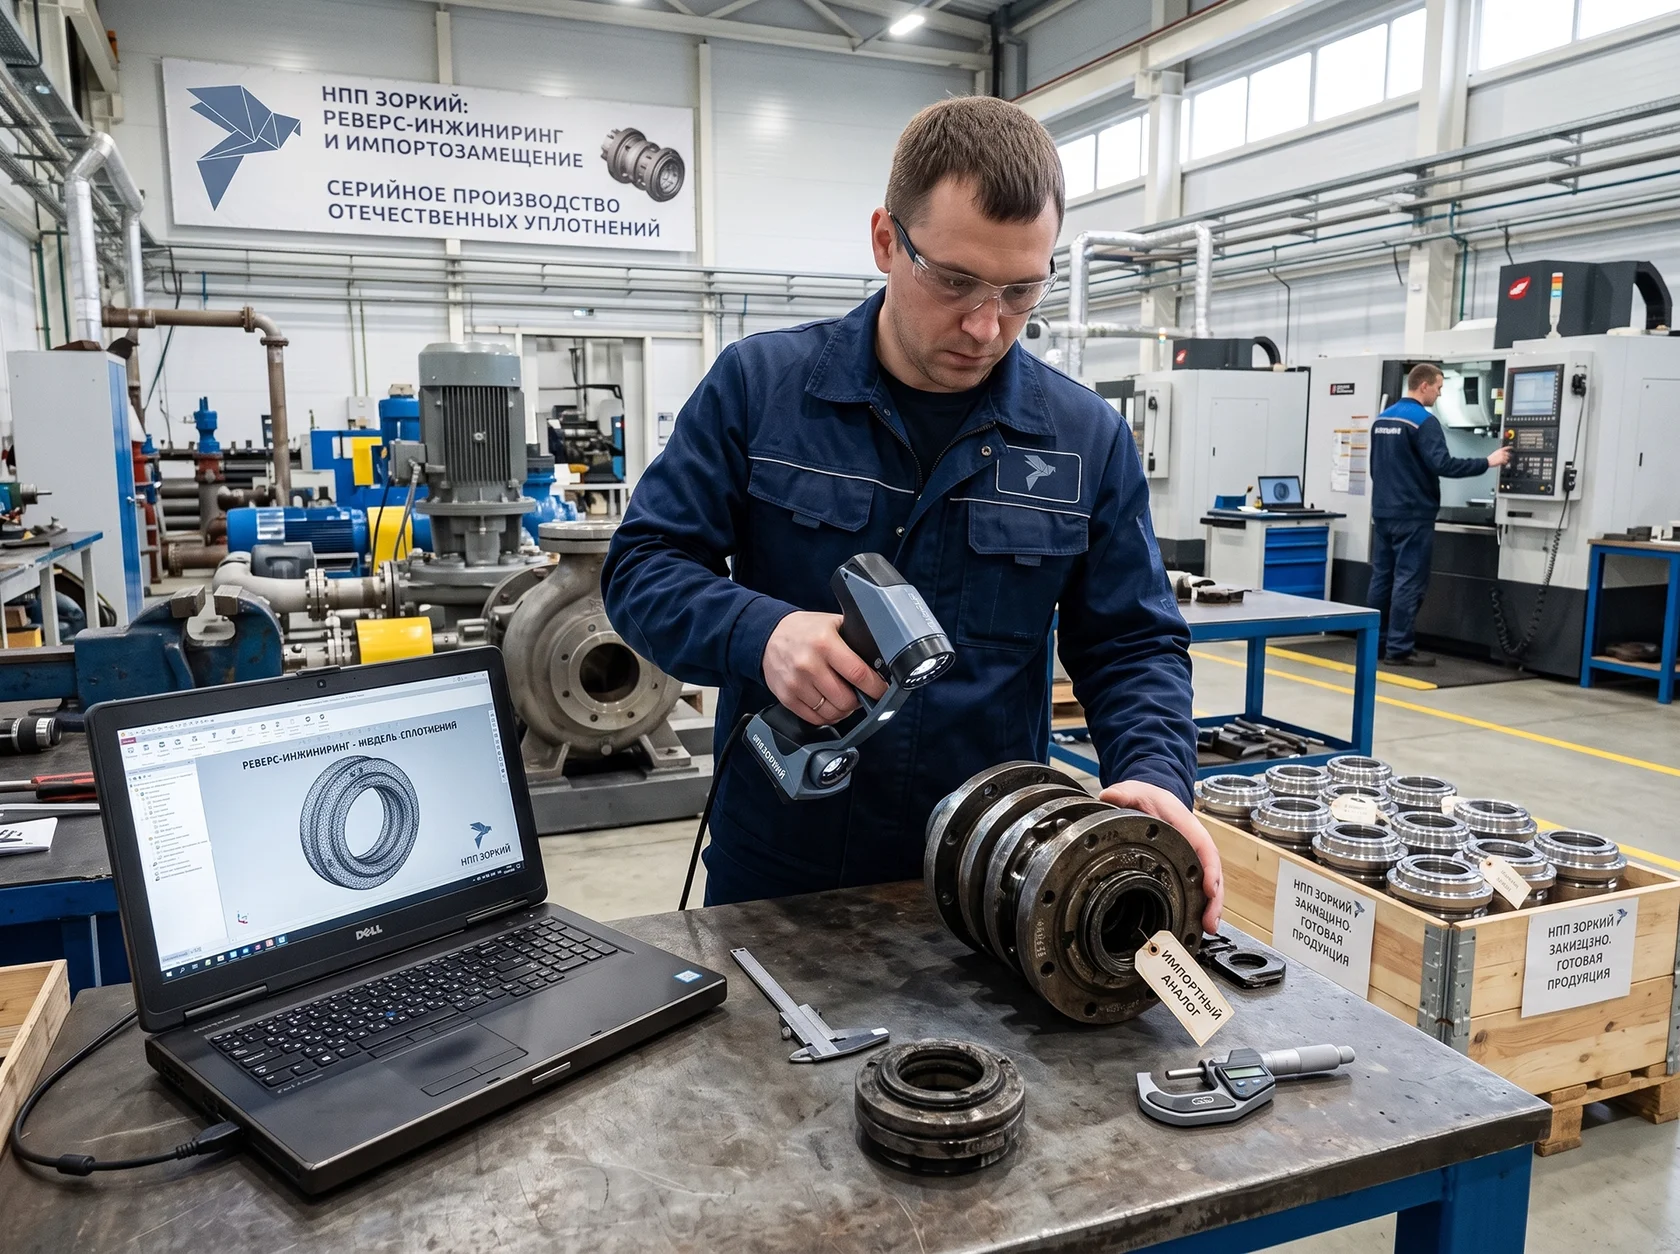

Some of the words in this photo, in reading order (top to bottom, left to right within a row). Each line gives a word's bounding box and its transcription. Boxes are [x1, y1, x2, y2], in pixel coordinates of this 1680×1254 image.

[322, 86, 368, 105] НПП
[375, 91, 468, 113] ЗОРКИЙ:
[323, 110, 564, 144] РЕВЕРС-ИНЖИНИРИНГ
[324, 133, 339, 150] И
[346, 135, 584, 168] ИМПОРТОЗАМЕЩЕНИЕ
[327, 179, 446, 202] СЕРИЙНОЕ
[453, 188, 620, 213] ПРОИЗВОДСТВО
[328, 203, 518, 230] ОТЕЧЕСТВЕННЫХ
[524, 215, 660, 237] УПЛОТНЕНИЙ
[242, 741, 350, 770] РЕВЕРС-ИНЖИНИРИНГ
[461, 854, 479, 867] НПП
[480, 843, 511, 861] ЗОРКИЙ
[1293, 879, 1313, 896] НПП
[1315, 889, 1352, 915] ЗОРКИЙ
[355, 924, 383, 940] DELL
[1301, 916, 1343, 946] ГОТОВАЯ
[1548, 923, 1570, 938] НПП
[1573, 913, 1614, 934] ЗОРКИЙ
[1557, 952, 1603, 971] ГОТОВАЯ
[1161, 950, 1223, 1020] ИМПОРТНЫЙ
[1161, 975, 1201, 1016] АНАЛОГ
